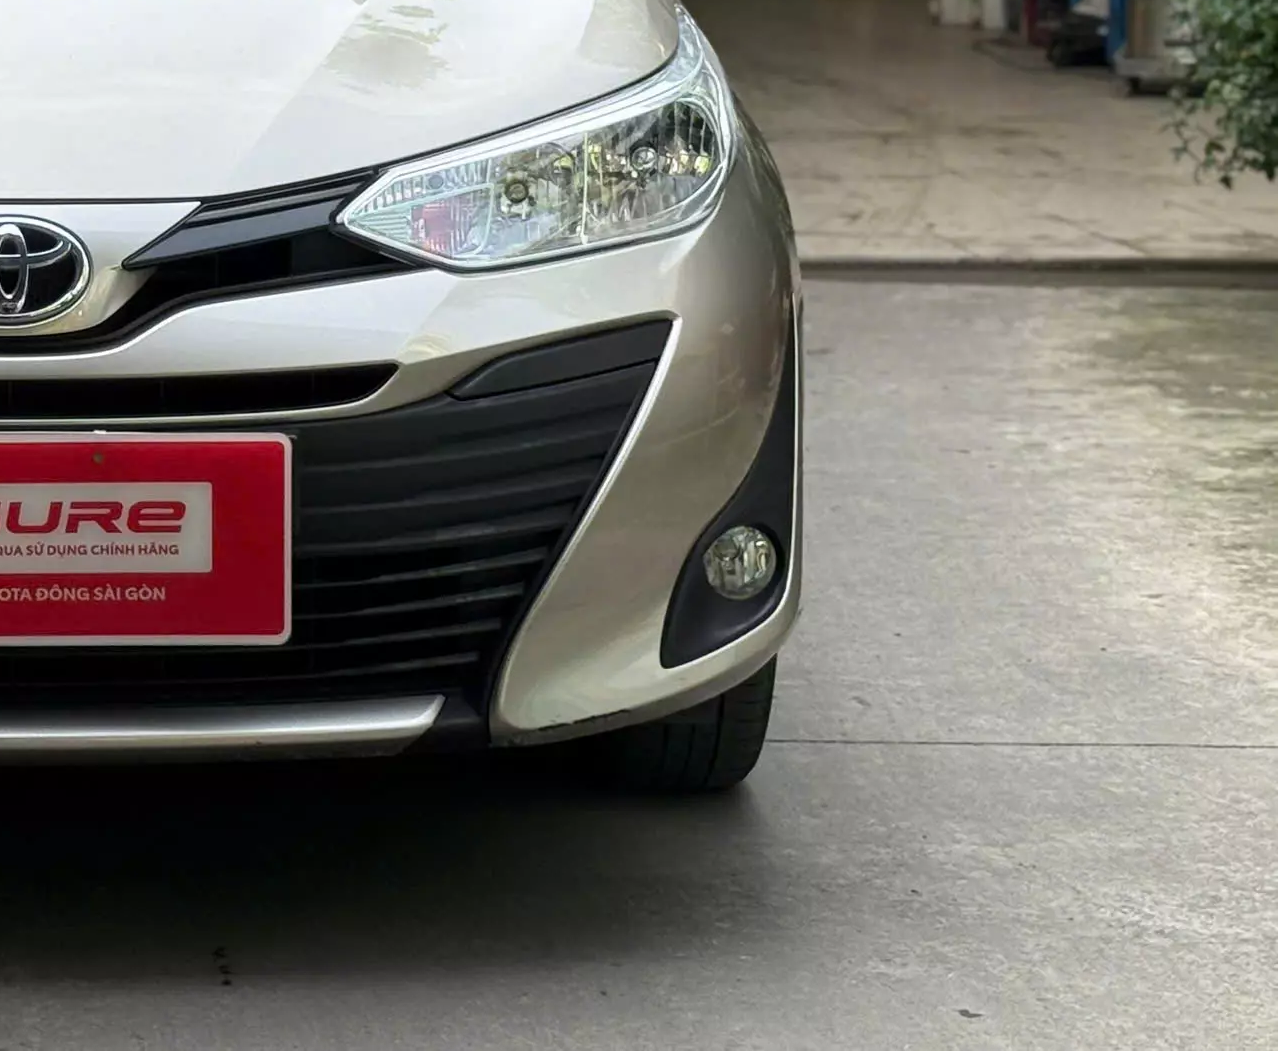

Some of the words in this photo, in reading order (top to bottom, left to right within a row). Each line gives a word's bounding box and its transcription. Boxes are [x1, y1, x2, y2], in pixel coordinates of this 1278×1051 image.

[47, 544, 88, 560] DỤNG
[90, 541, 135, 557] CHÍNH
[138, 541, 179, 556] HÃNG
[35, 583, 90, 603] ĐÔNG
[93, 583, 121, 602] SÀI
[125, 583, 166, 602] GÒN
